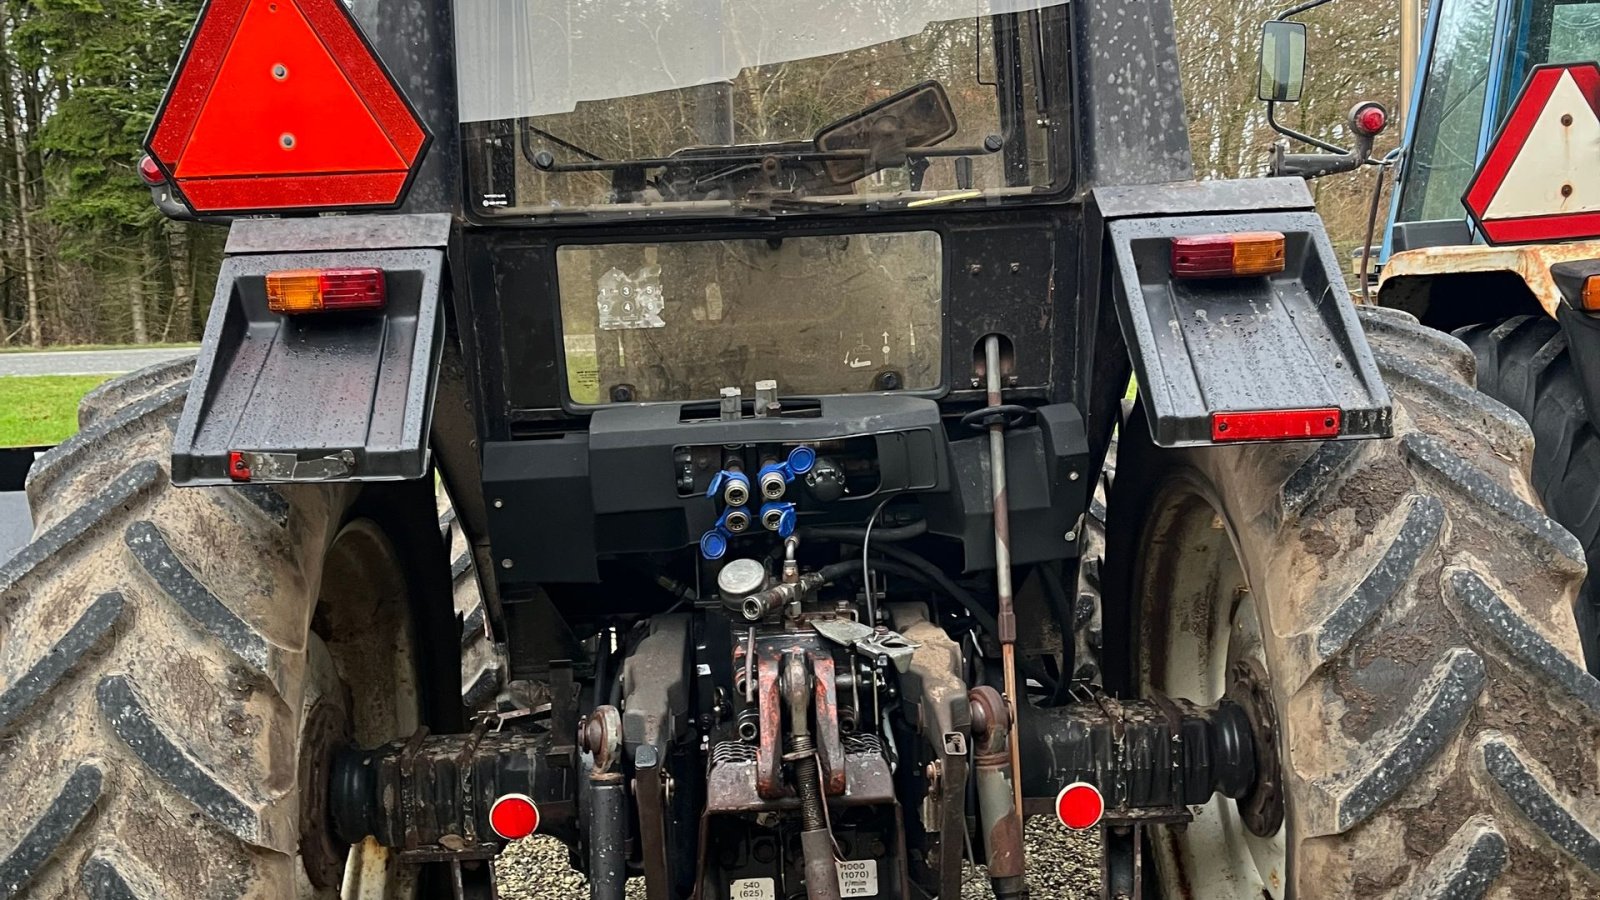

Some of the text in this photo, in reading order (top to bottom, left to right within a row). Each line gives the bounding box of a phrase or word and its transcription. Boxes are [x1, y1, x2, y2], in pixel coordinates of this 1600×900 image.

[623, 287, 630, 295] 3
[646, 286, 653, 294] 5
[602, 304, 609, 312] 2
[624, 303, 631, 311] 4
[841, 871, 869, 879] (1070)
[743, 881, 760, 889] 540
[740, 890, 764, 898] (625)
